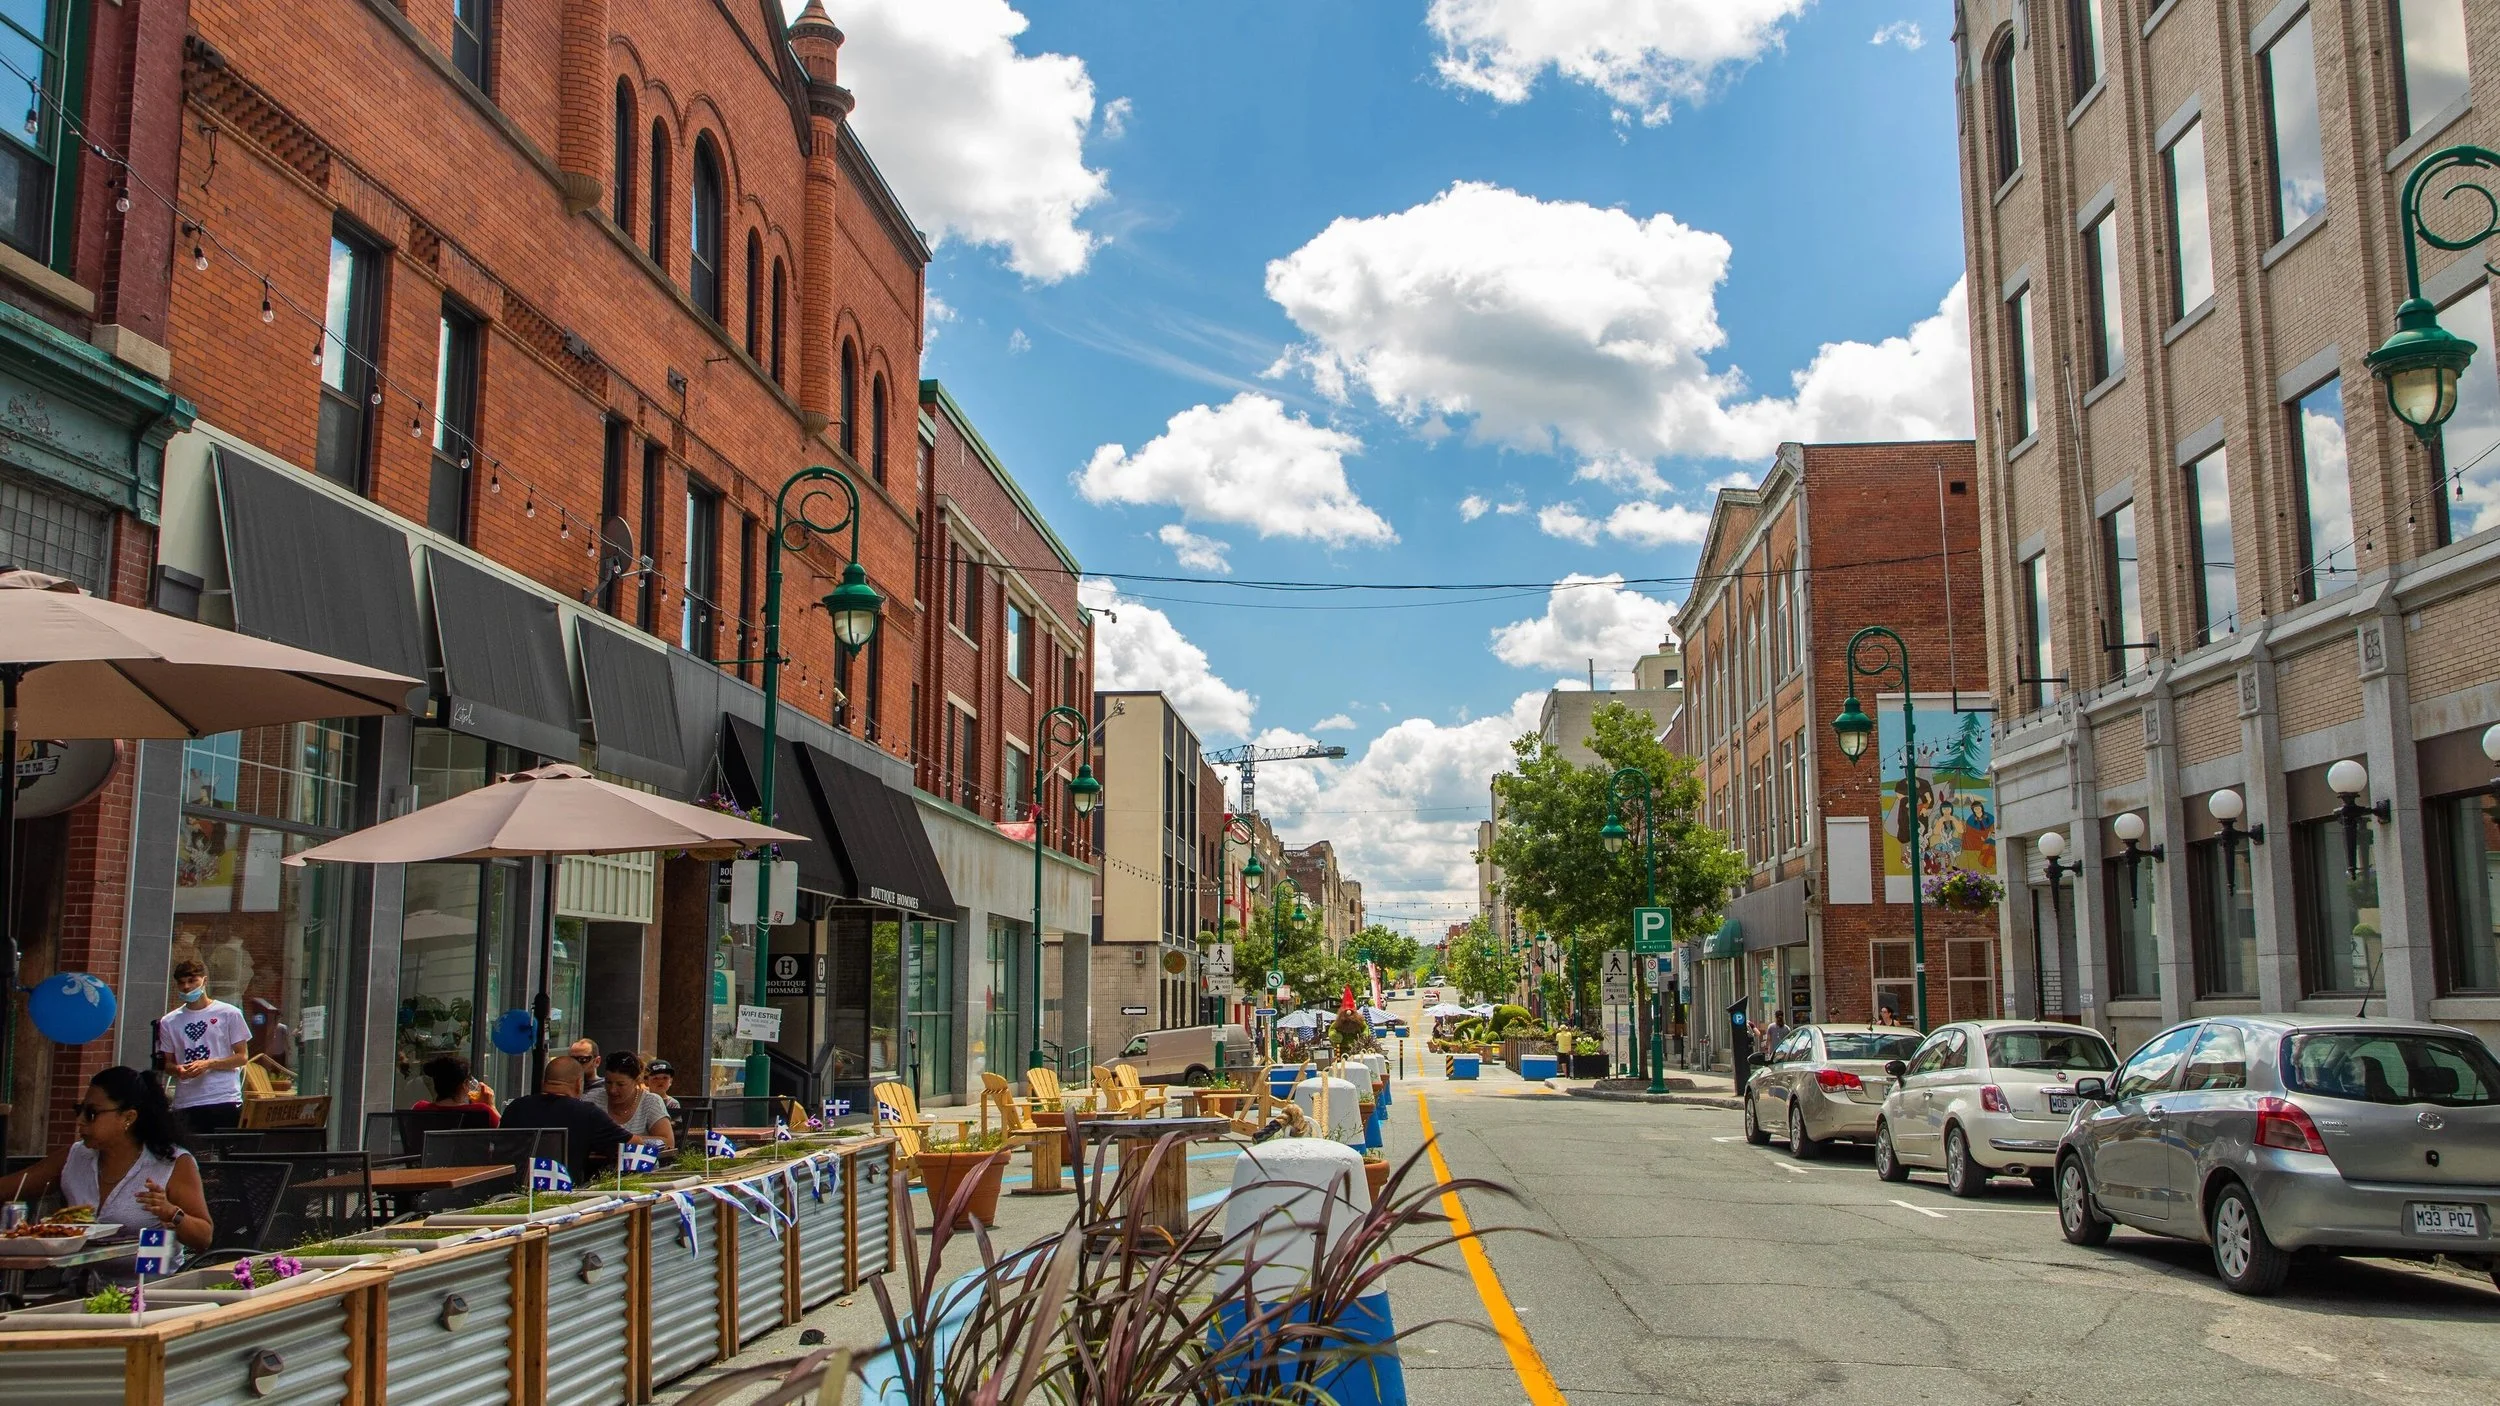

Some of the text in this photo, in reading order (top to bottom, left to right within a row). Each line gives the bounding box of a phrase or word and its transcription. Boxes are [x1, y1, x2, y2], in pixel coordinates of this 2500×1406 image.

[871, 886, 919, 909] BOUTIQUE HOMMES
[1642, 912, 1665, 940] P
[766, 980, 807, 988] BOUTIQUE
[741, 1010, 780, 1020] WIFI ESTRIE
[1736, 1014, 1743, 1022] P
[2416, 1210, 2474, 1228] M33 PQZ
